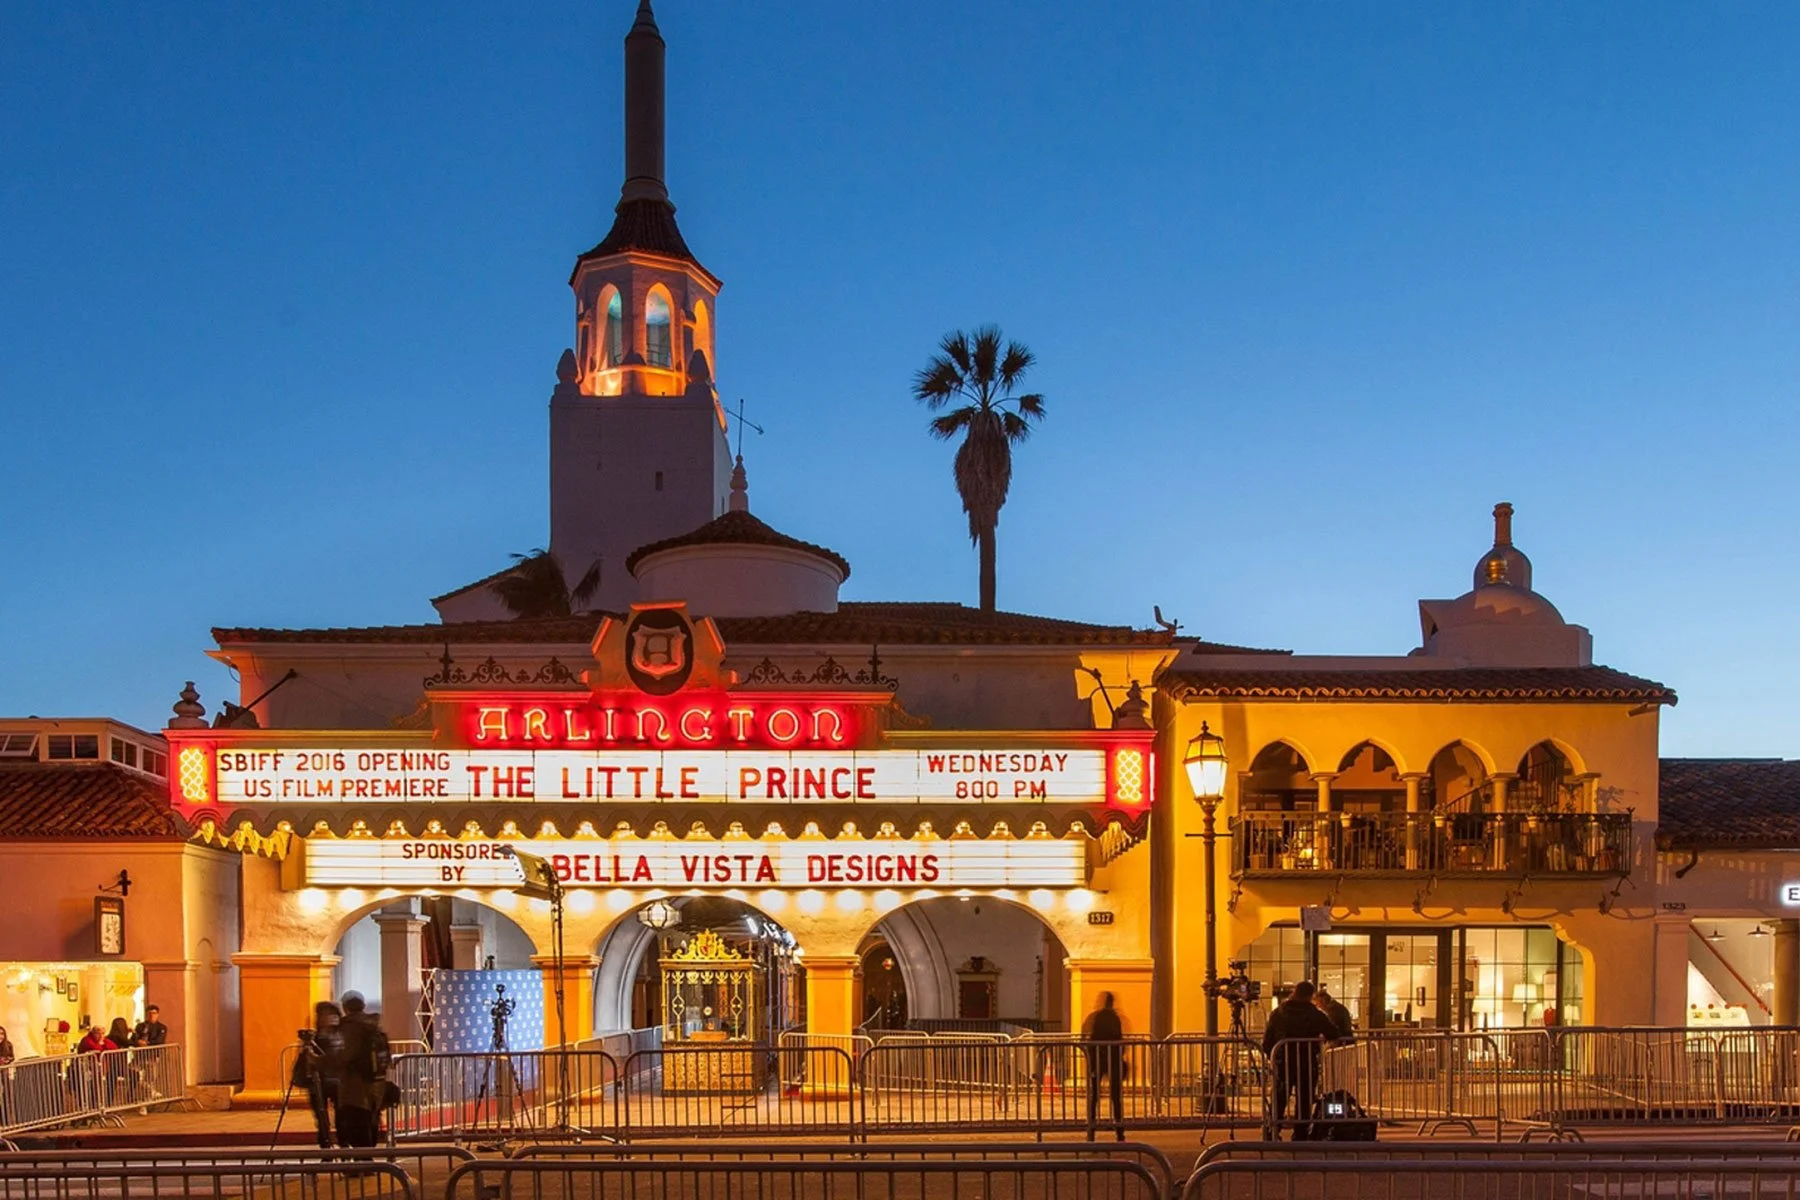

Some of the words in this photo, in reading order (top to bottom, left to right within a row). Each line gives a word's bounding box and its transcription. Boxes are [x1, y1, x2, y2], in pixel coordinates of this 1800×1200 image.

[476, 708, 844, 742] ARLINGTON
[219, 753, 285, 772] SBIFF
[296, 753, 346, 772] 2016
[358, 752, 451, 772] OPENING
[926, 754, 1069, 773] WEDNESDAY
[244, 779, 272, 798] US
[282, 779, 334, 798] FILM
[340, 778, 450, 798] PREMIERE
[466, 766, 534, 799] THE
[562, 766, 699, 799] LITTLE
[739, 767, 877, 799] PRINCE
[955, 780, 999, 799] 800
[1014, 780, 1047, 799] PM
[441, 865, 466, 882] BY
[552, 854, 654, 882] BELLA
[679, 854, 778, 883] VISTA
[807, 854, 940, 882] DESIGNS
[1090, 913, 1111, 923] 1317
